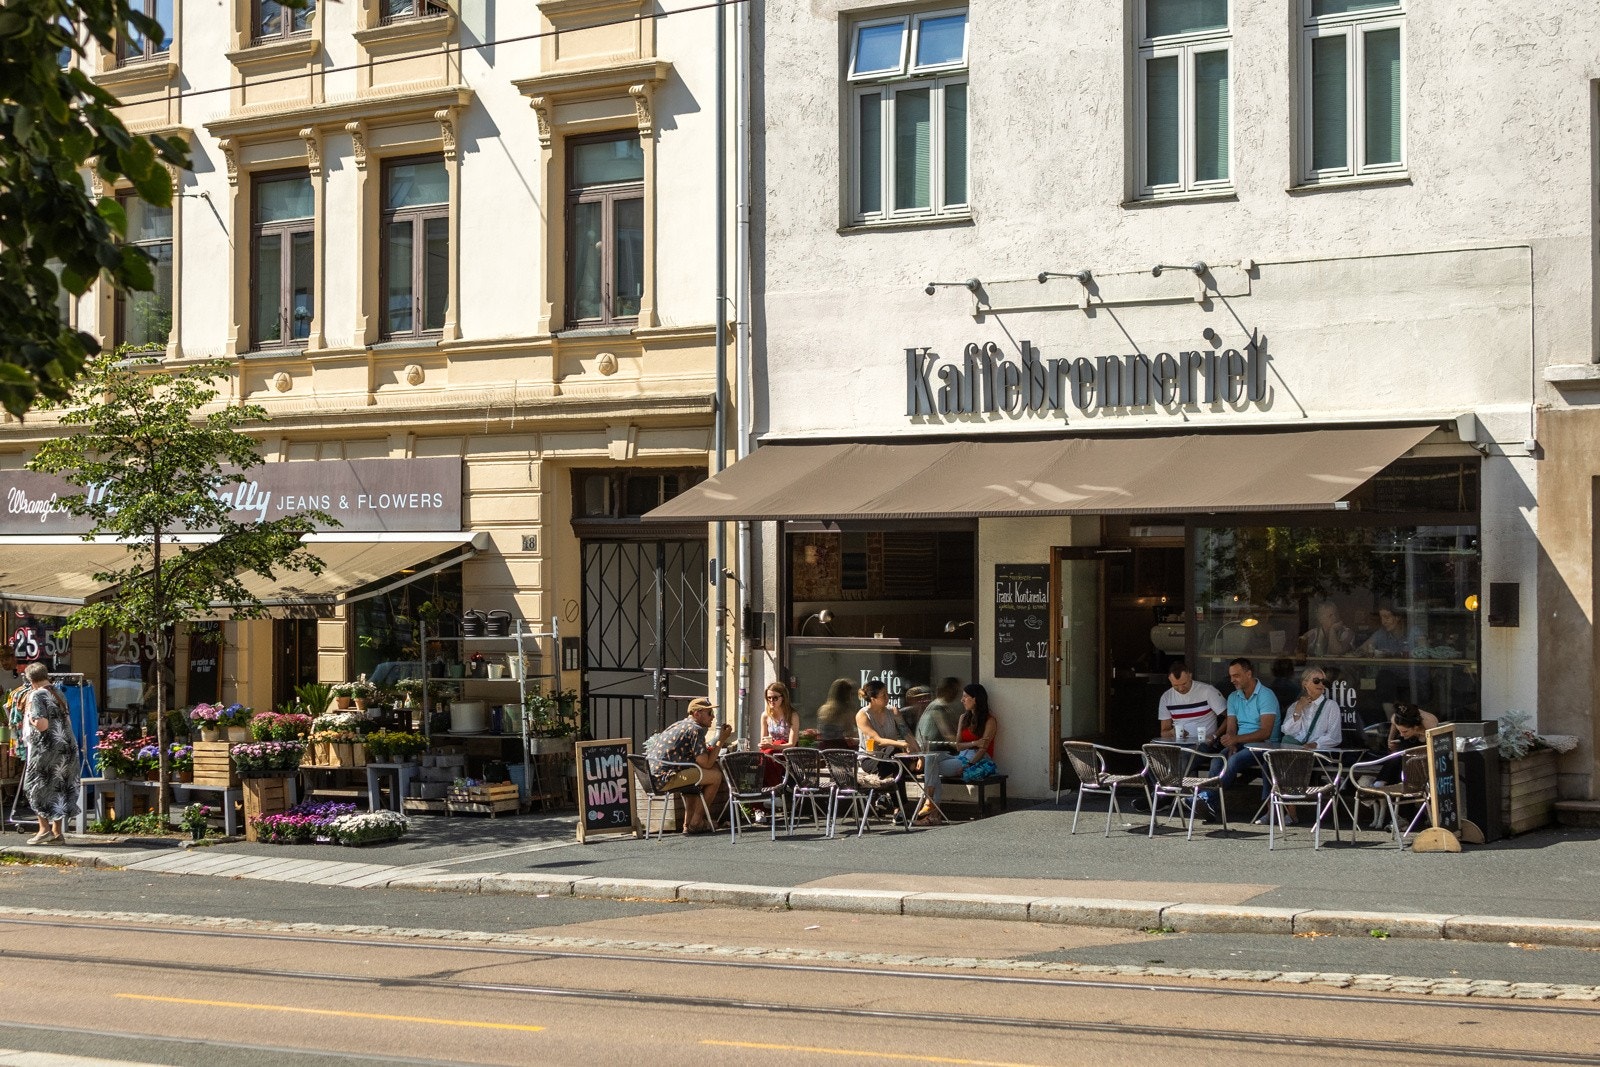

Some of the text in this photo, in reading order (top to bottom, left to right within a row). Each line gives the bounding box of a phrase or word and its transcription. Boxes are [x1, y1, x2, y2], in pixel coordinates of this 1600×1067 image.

[904, 327, 1267, 416] Kaffebrenneriet
[277, 495, 330, 510] JEANS
[339, 495, 349, 509] &
[358, 493, 443, 509] FLOWERS
[1324, 680, 1357, 708] ffe
[585, 754, 628, 780] LIMO-
[587, 778, 629, 807] NADE
